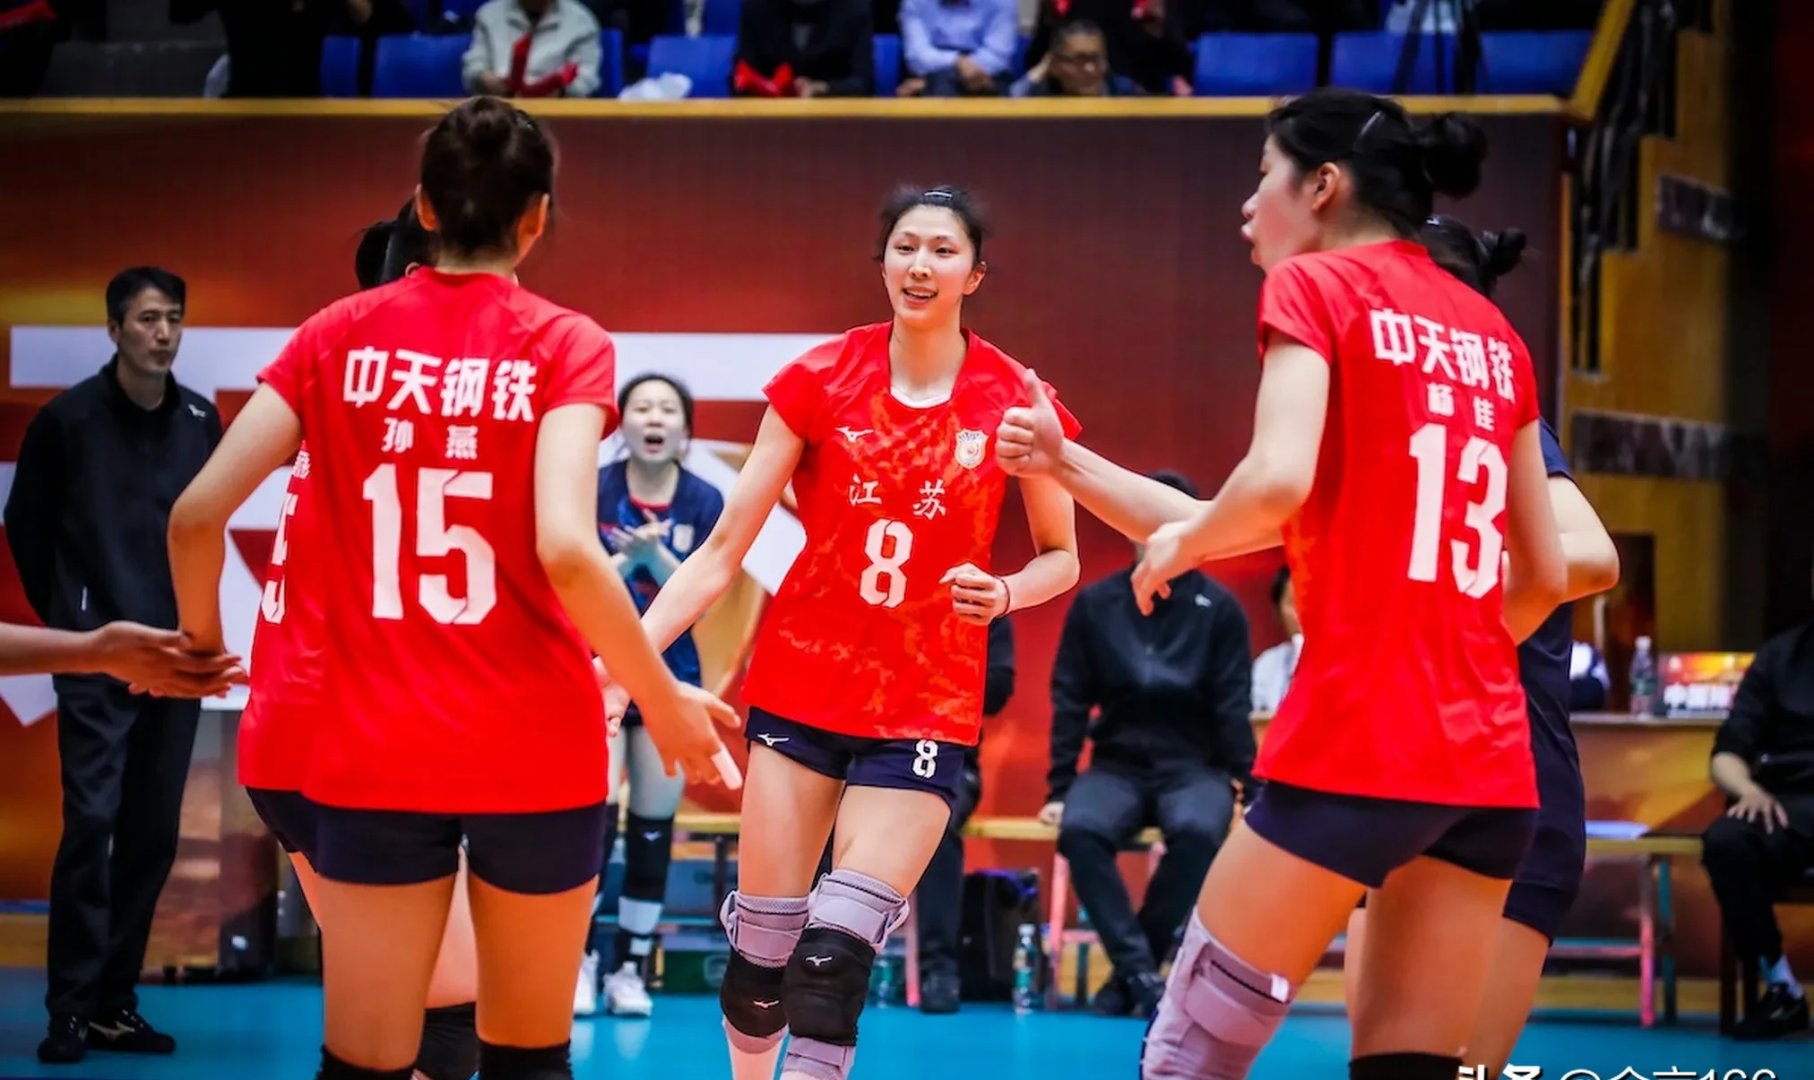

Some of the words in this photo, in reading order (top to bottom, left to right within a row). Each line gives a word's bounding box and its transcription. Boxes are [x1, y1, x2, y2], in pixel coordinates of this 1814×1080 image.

[343, 346, 537, 422] 中天钢铁
[1370, 307, 1515, 404] 中天钢铁
[849, 473, 947, 520] 江苏
[1407, 422, 1508, 600] 13
[362, 463, 497, 625] 15
[860, 518, 914, 608] 8
[912, 739, 938, 778] 8
